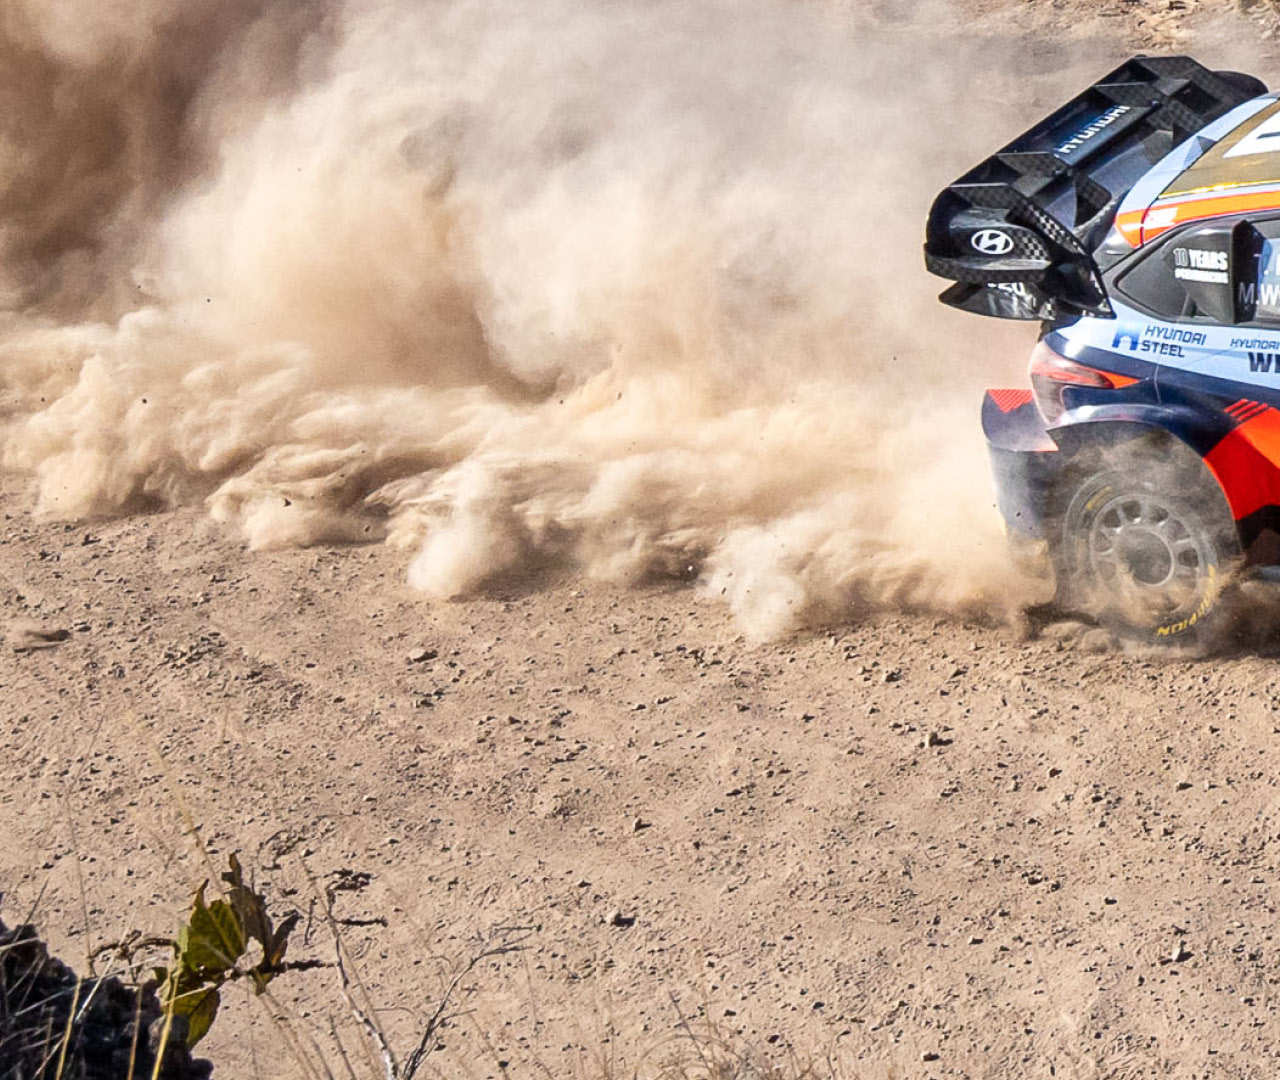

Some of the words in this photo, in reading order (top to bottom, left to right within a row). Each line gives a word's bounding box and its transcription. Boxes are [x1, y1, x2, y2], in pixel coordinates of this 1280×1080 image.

[1188, 249, 1229, 271] YEARS
[1144, 324, 1208, 346] HYUNDAI
[1230, 338, 1280, 350] HYUNDAI
[1140, 339, 1186, 358] STEEL
